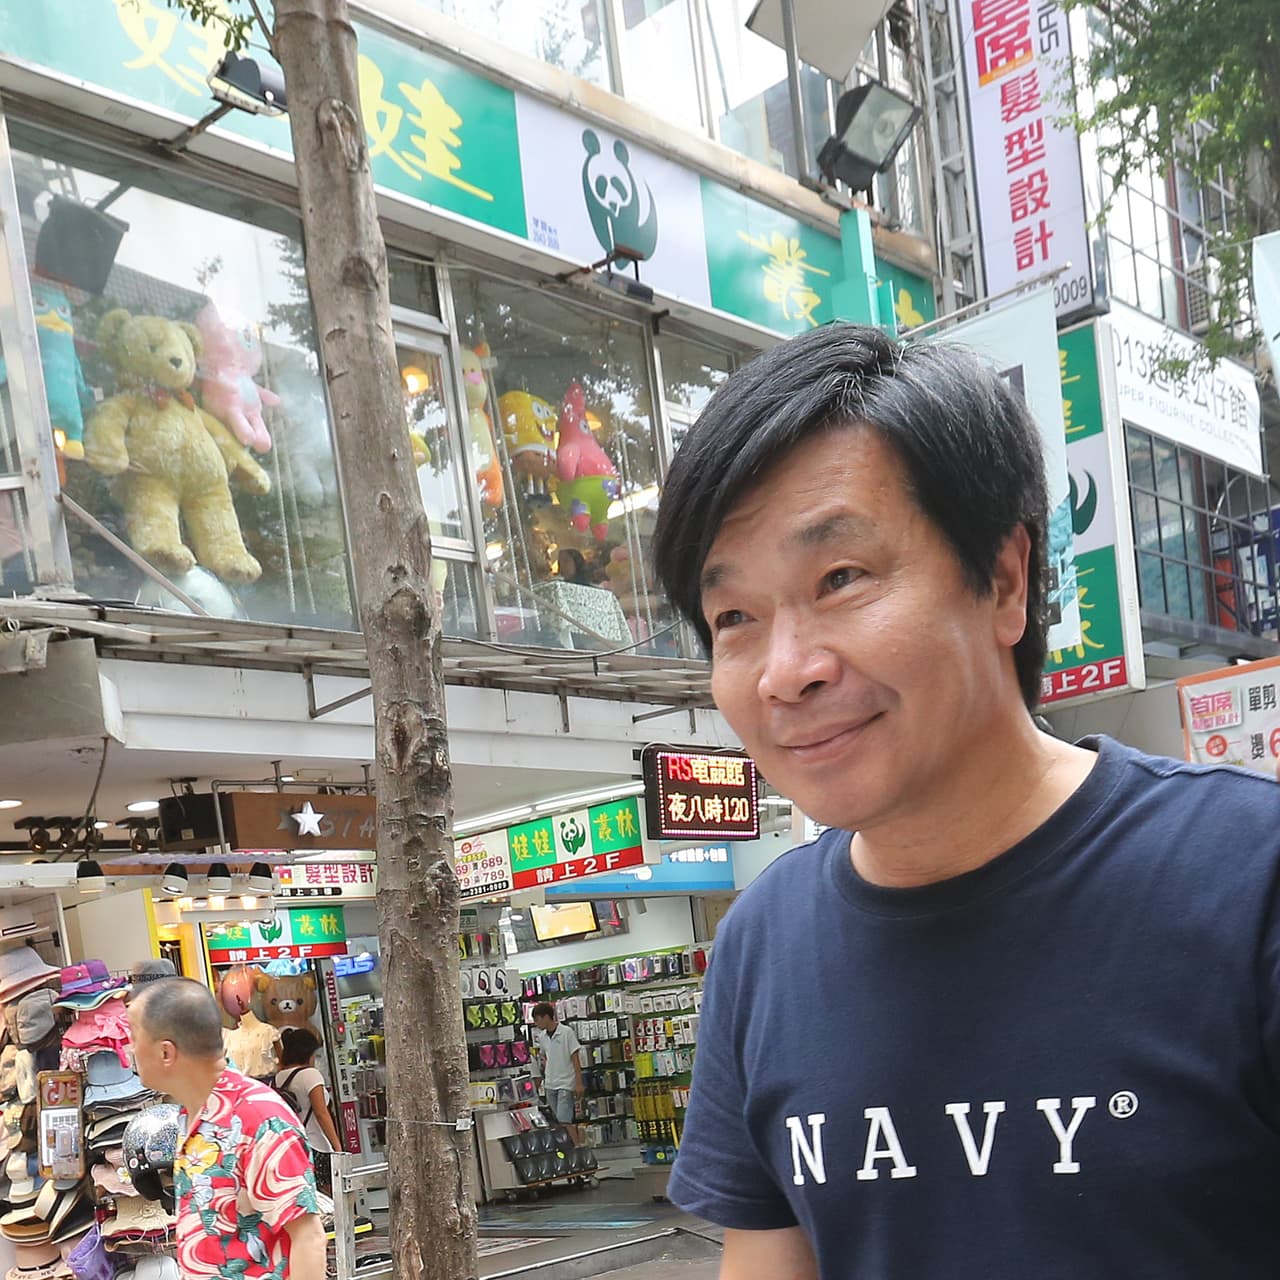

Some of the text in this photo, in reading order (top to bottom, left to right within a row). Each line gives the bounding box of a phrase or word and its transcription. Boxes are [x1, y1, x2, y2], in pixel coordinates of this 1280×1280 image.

[1001, 68, 1053, 272] 髮型設計
[667, 757, 745, 786] RS電競館
[667, 793, 749, 824] 夜八時120
[592, 808, 639, 842] 叢林
[511, 828, 555, 861] 娃娃
[481, 855, 504, 870] 689
[482, 869, 505, 883] 789
[536, 851, 621, 885] 請上2F
[227, 945, 314, 963] 請上2F
